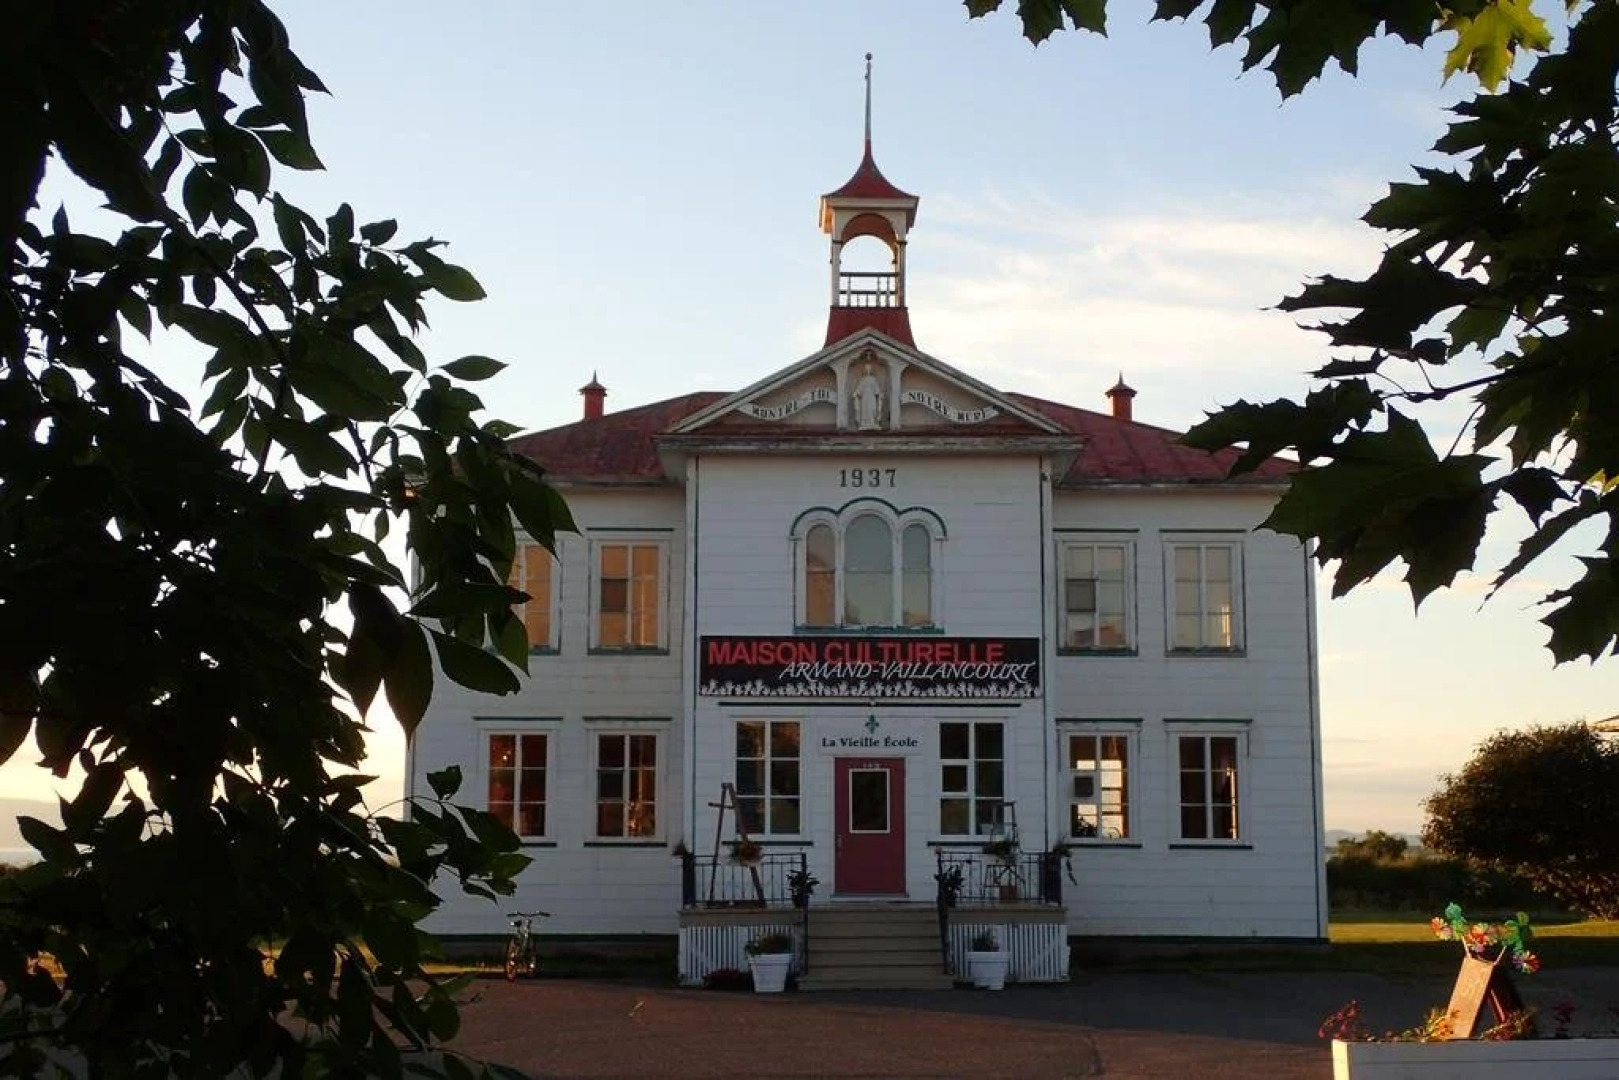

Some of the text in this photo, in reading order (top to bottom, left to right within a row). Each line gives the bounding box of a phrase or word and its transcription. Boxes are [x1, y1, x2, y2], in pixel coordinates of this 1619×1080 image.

[840, 469, 896, 488] 1937
[708, 641, 1004, 665] MAISON CULTURELLE
[779, 660, 1036, 684] ARMAND-VAILLANCOURT
[822, 735, 918, 747] La Vieille École
